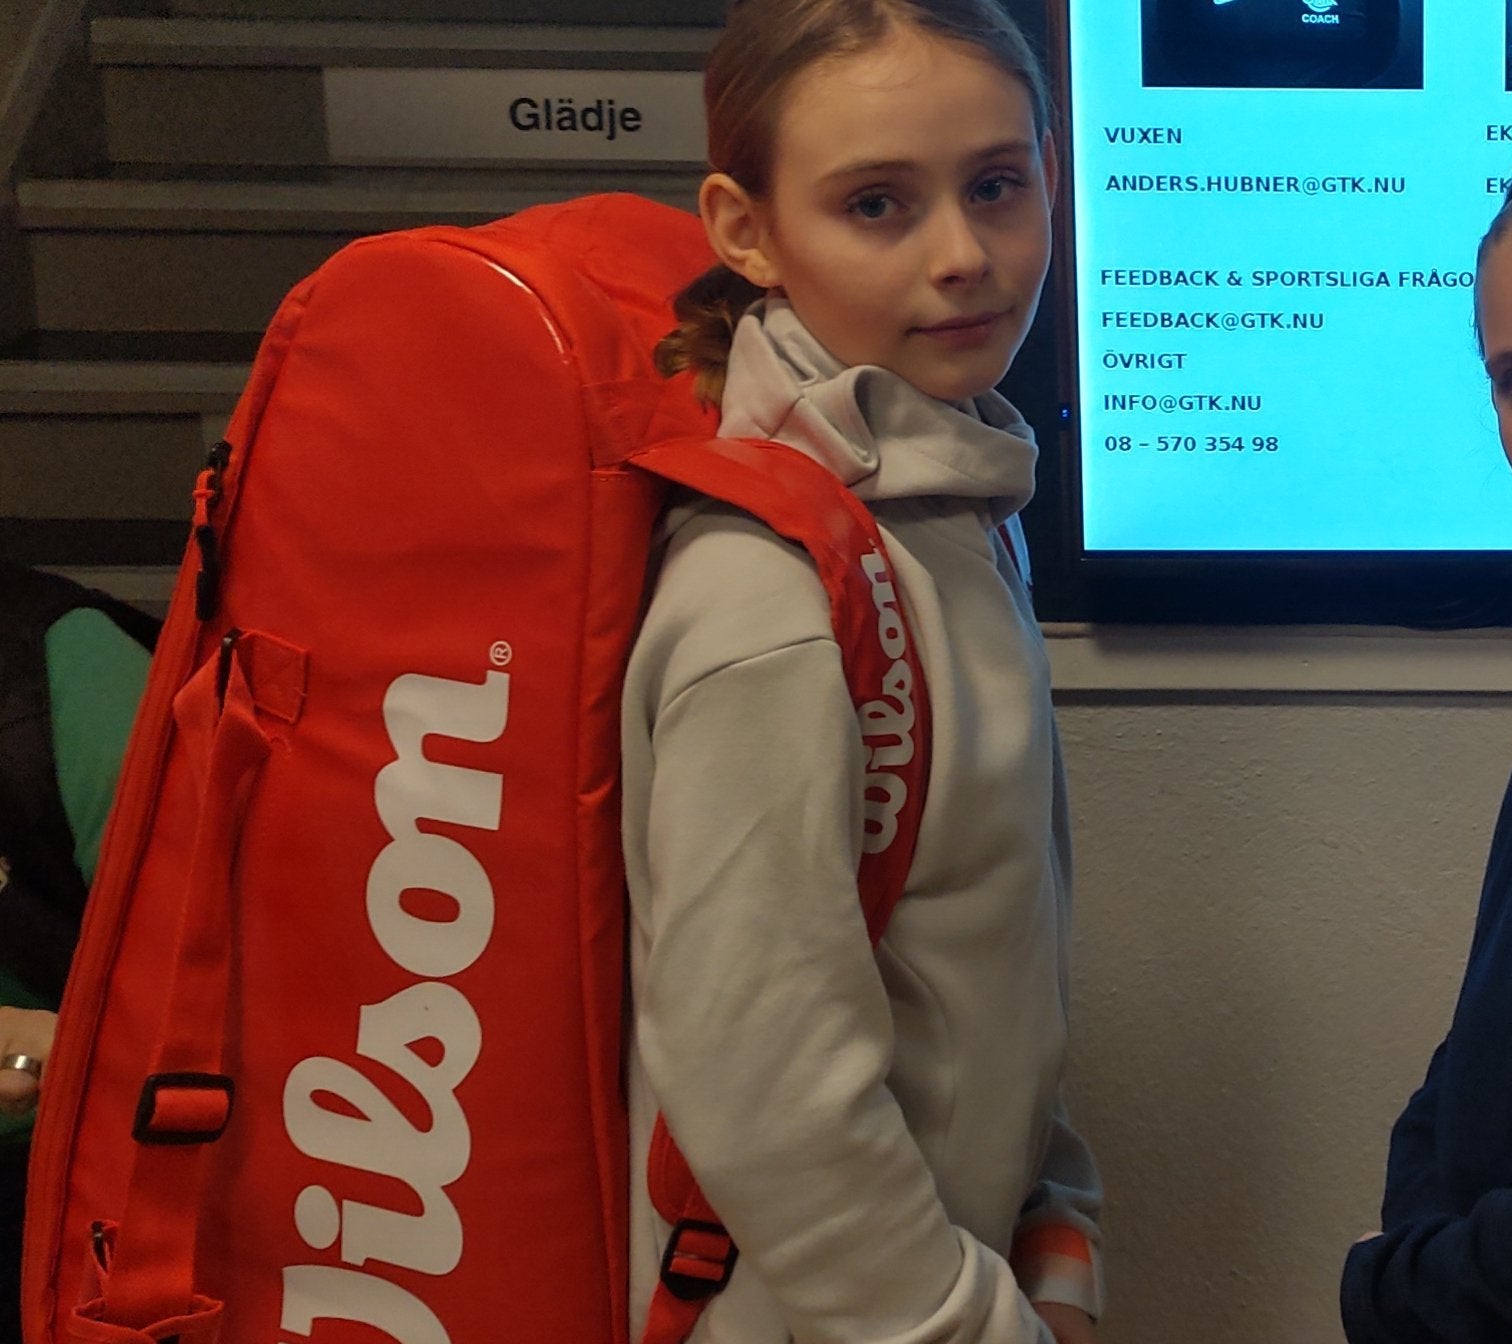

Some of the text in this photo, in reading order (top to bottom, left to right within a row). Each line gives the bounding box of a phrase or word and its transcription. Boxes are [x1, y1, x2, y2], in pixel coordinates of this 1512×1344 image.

[1302, 13, 1340, 24] COACH
[509, 97, 642, 141] Glädje
[1105, 128, 1181, 143] VUXEN
[1106, 175, 1404, 195] ANDERS.HUBNER@GTK.NU
[1102, 270, 1219, 286] FEEDBACK
[1227, 271, 1242, 286] &
[1252, 271, 1390, 287] SPORTSLIGA
[1103, 312, 1323, 331] FEEDBACK@GTK.NU
[1103, 350, 1187, 369] ÖVRIGT
[1105, 395, 1261, 413] INFO@GTK.NU
[1105, 436, 1131, 451] 08
[1157, 437, 1196, 451] 570
[1205, 437, 1244, 451] 354
[1252, 437, 1278, 451] 98
